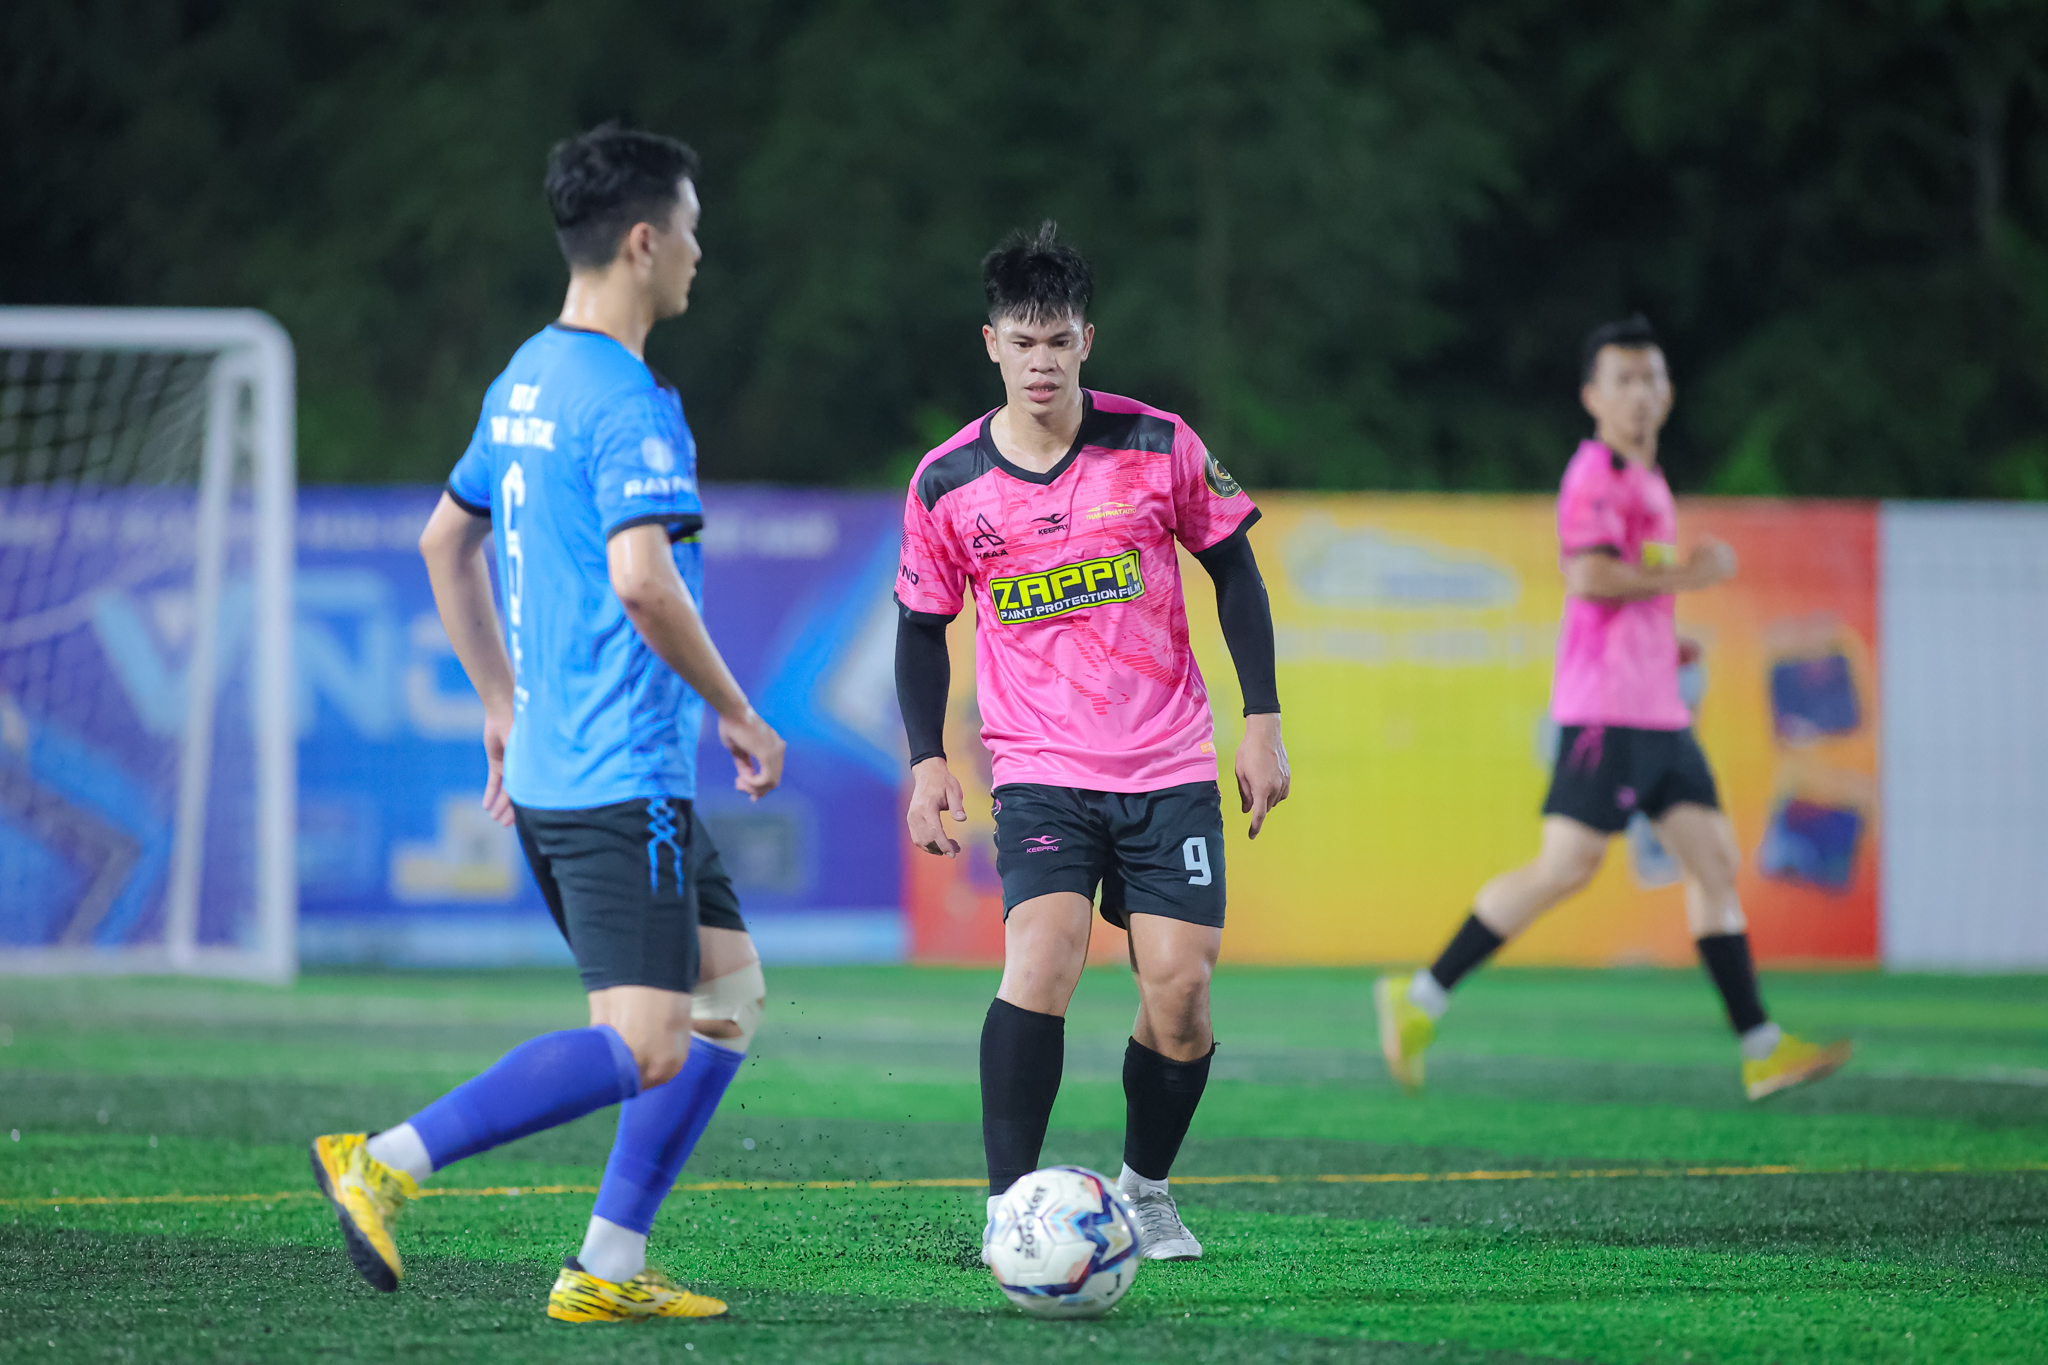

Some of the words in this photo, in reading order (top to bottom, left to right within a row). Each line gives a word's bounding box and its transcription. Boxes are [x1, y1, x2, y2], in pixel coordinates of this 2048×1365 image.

[1038, 523, 1069, 536] KEEPFLY
[899, 560, 920, 586] NO
[992, 554, 1139, 610] ZAPPA
[1000, 607, 1033, 621] PAINT
[1036, 588, 1118, 616] PROTECTION
[1118, 582, 1141, 599] FILM
[1026, 845, 1059, 854] KEEPFLY
[1181, 836, 1212, 887] 9
